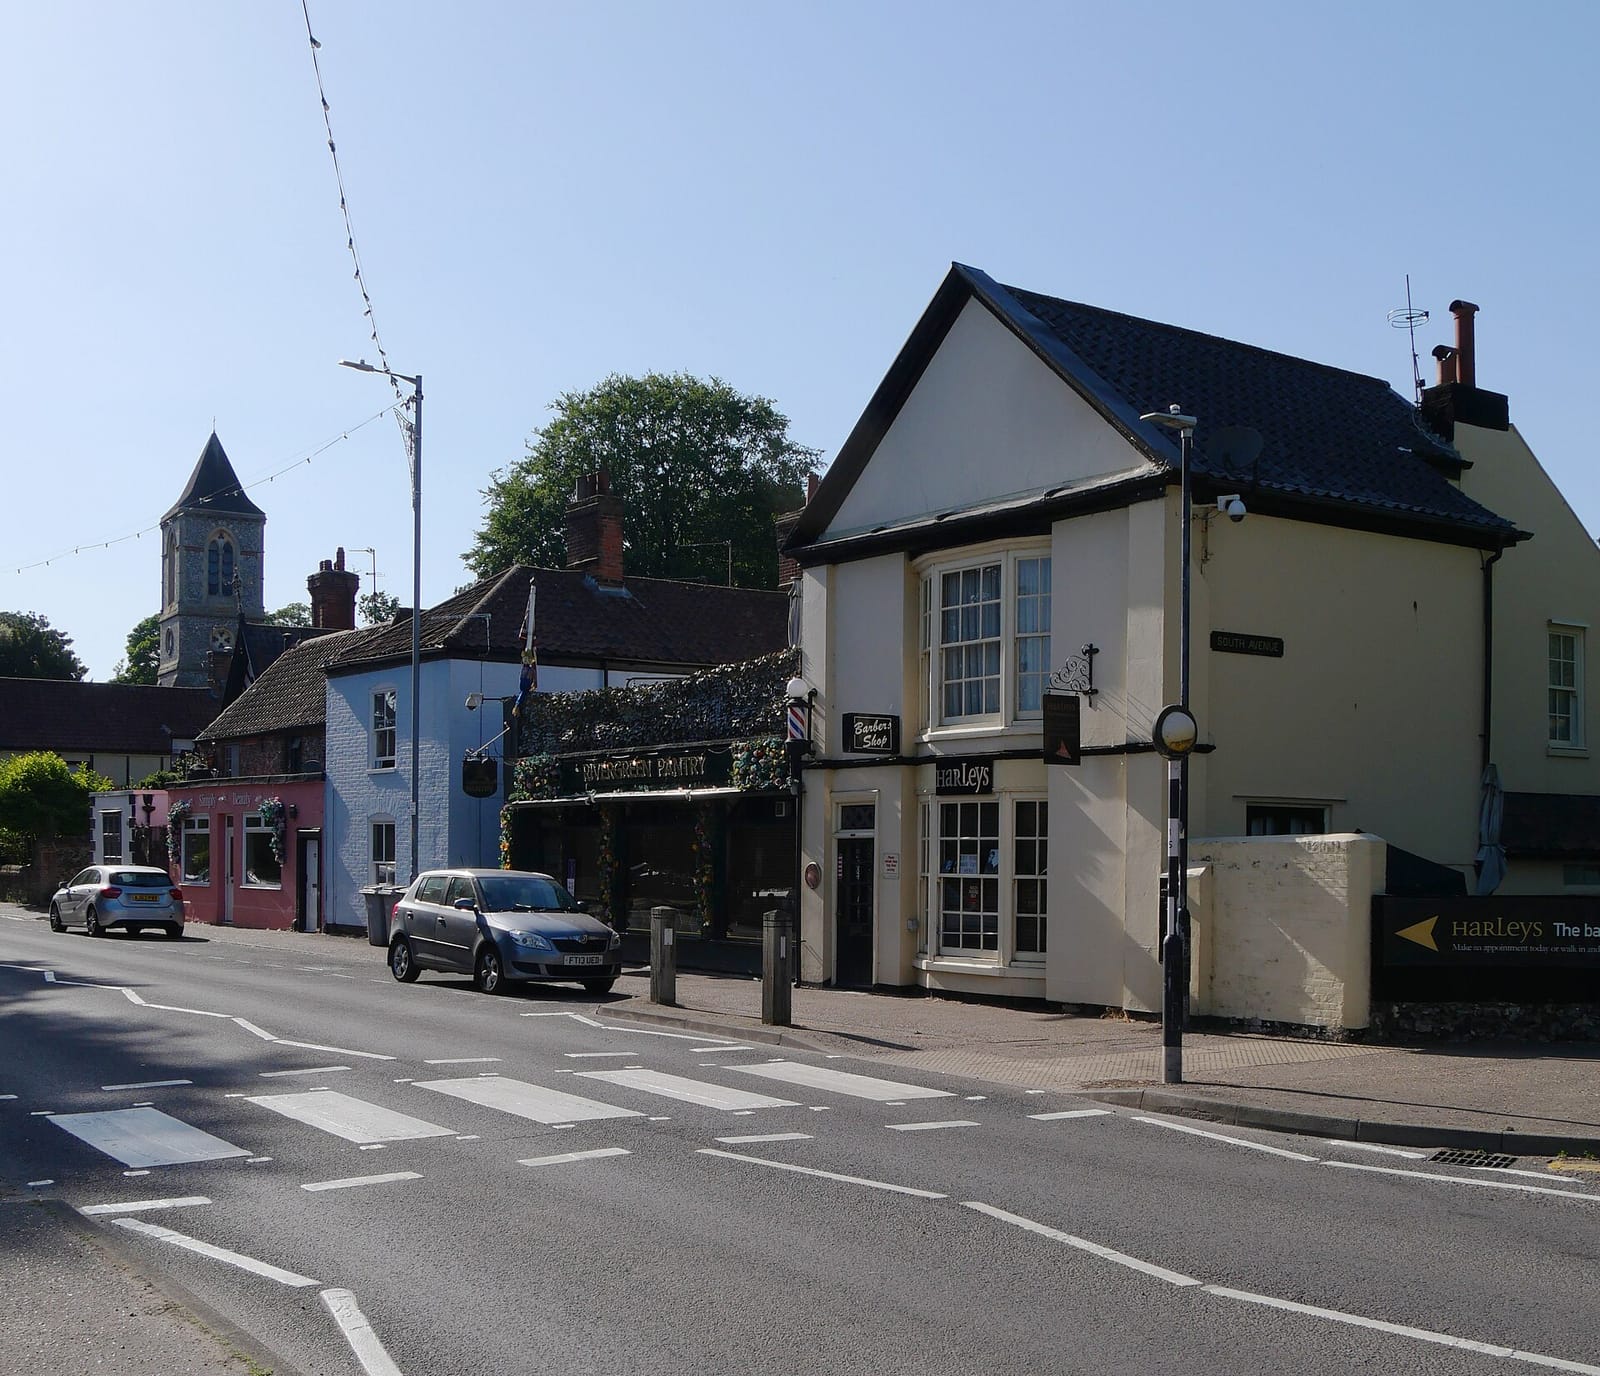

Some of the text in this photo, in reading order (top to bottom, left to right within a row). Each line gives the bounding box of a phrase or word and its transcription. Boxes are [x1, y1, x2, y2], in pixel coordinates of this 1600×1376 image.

[1217, 636, 1280, 652] SOUTH AVENUE
[854, 720, 892, 735] Barbers
[863, 735, 888, 749] Shop
[583, 755, 706, 782] RIVERGREEN PANTRY
[1553, 922, 1580, 937] The
[1451, 943, 1472, 952] Make
[1483, 943, 1528, 954] appointment
[1530, 943, 1549, 955] today
